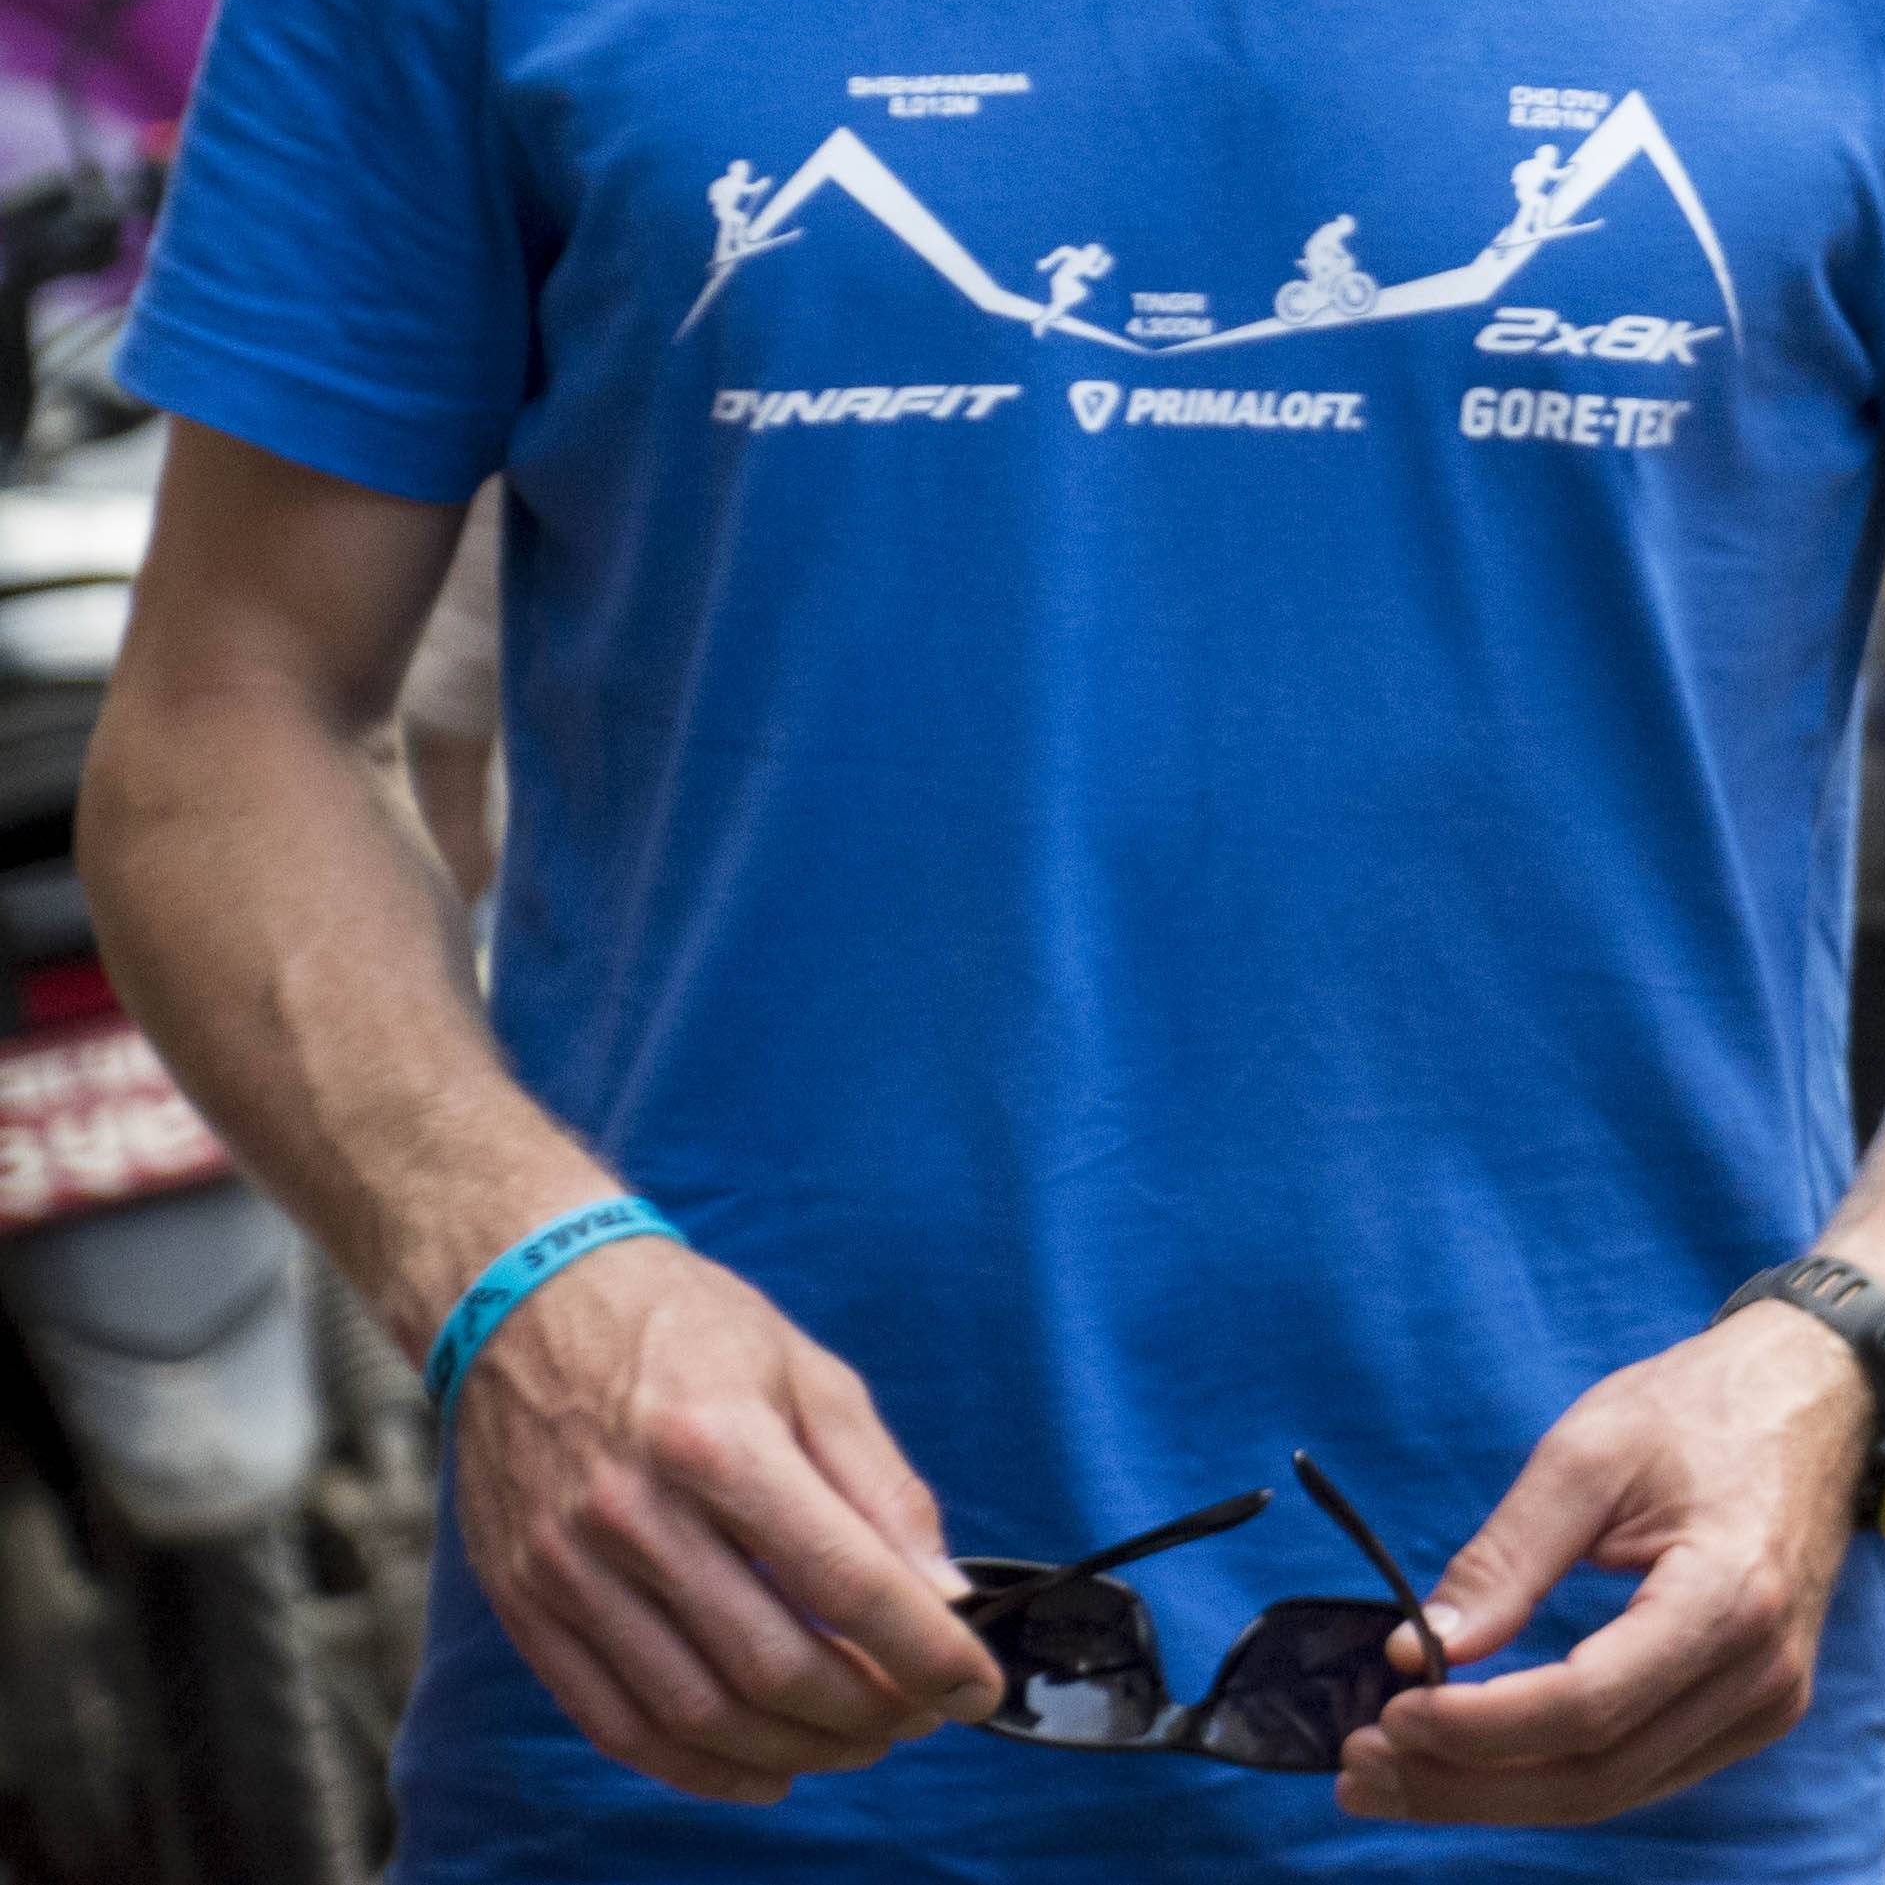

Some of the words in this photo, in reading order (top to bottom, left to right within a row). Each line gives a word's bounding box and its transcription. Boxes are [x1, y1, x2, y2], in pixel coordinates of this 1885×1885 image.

[1509, 86, 1558, 106] CHO
[712, 383, 1022, 430] DYNAFIT
[1460, 386, 1690, 448] GORE-TEX
